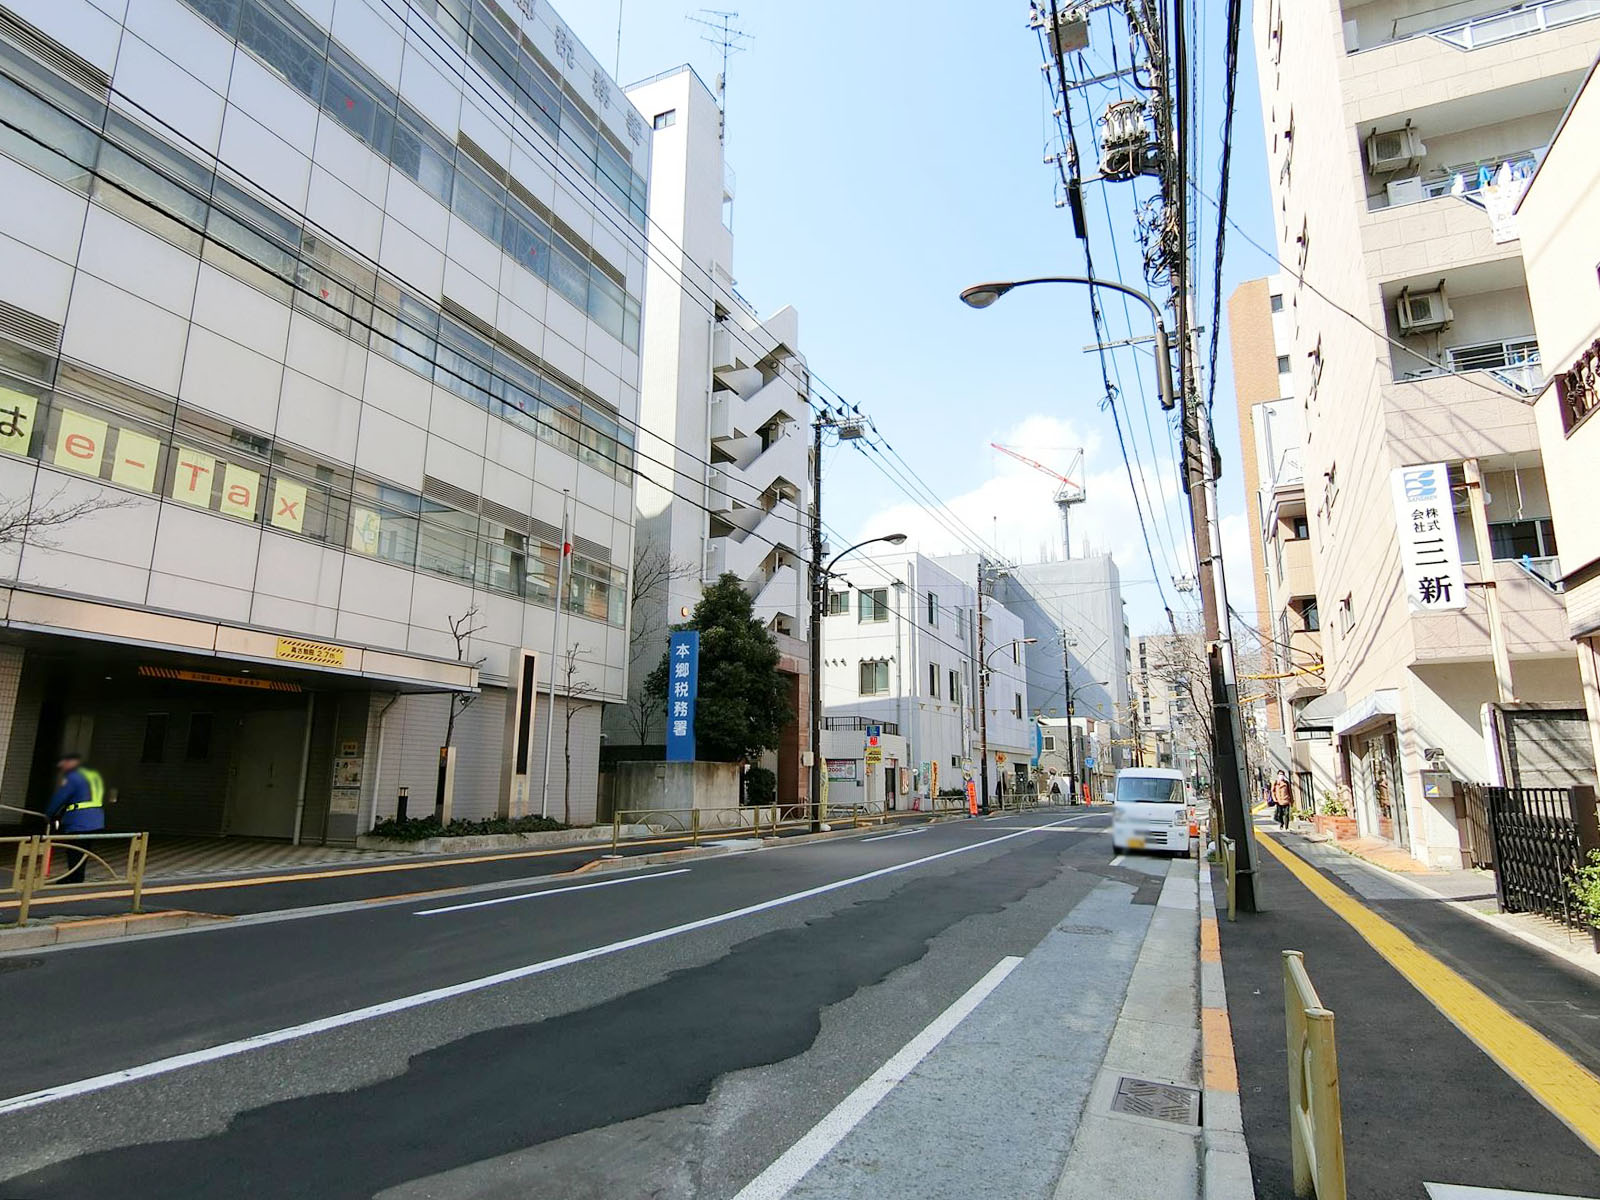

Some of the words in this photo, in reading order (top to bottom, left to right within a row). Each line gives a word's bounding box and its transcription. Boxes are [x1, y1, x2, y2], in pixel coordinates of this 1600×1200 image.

[65, 433, 300, 520] e-Tax
[1413, 538, 1453, 604] 三新
[673, 643, 689, 737] 本郷税務署
